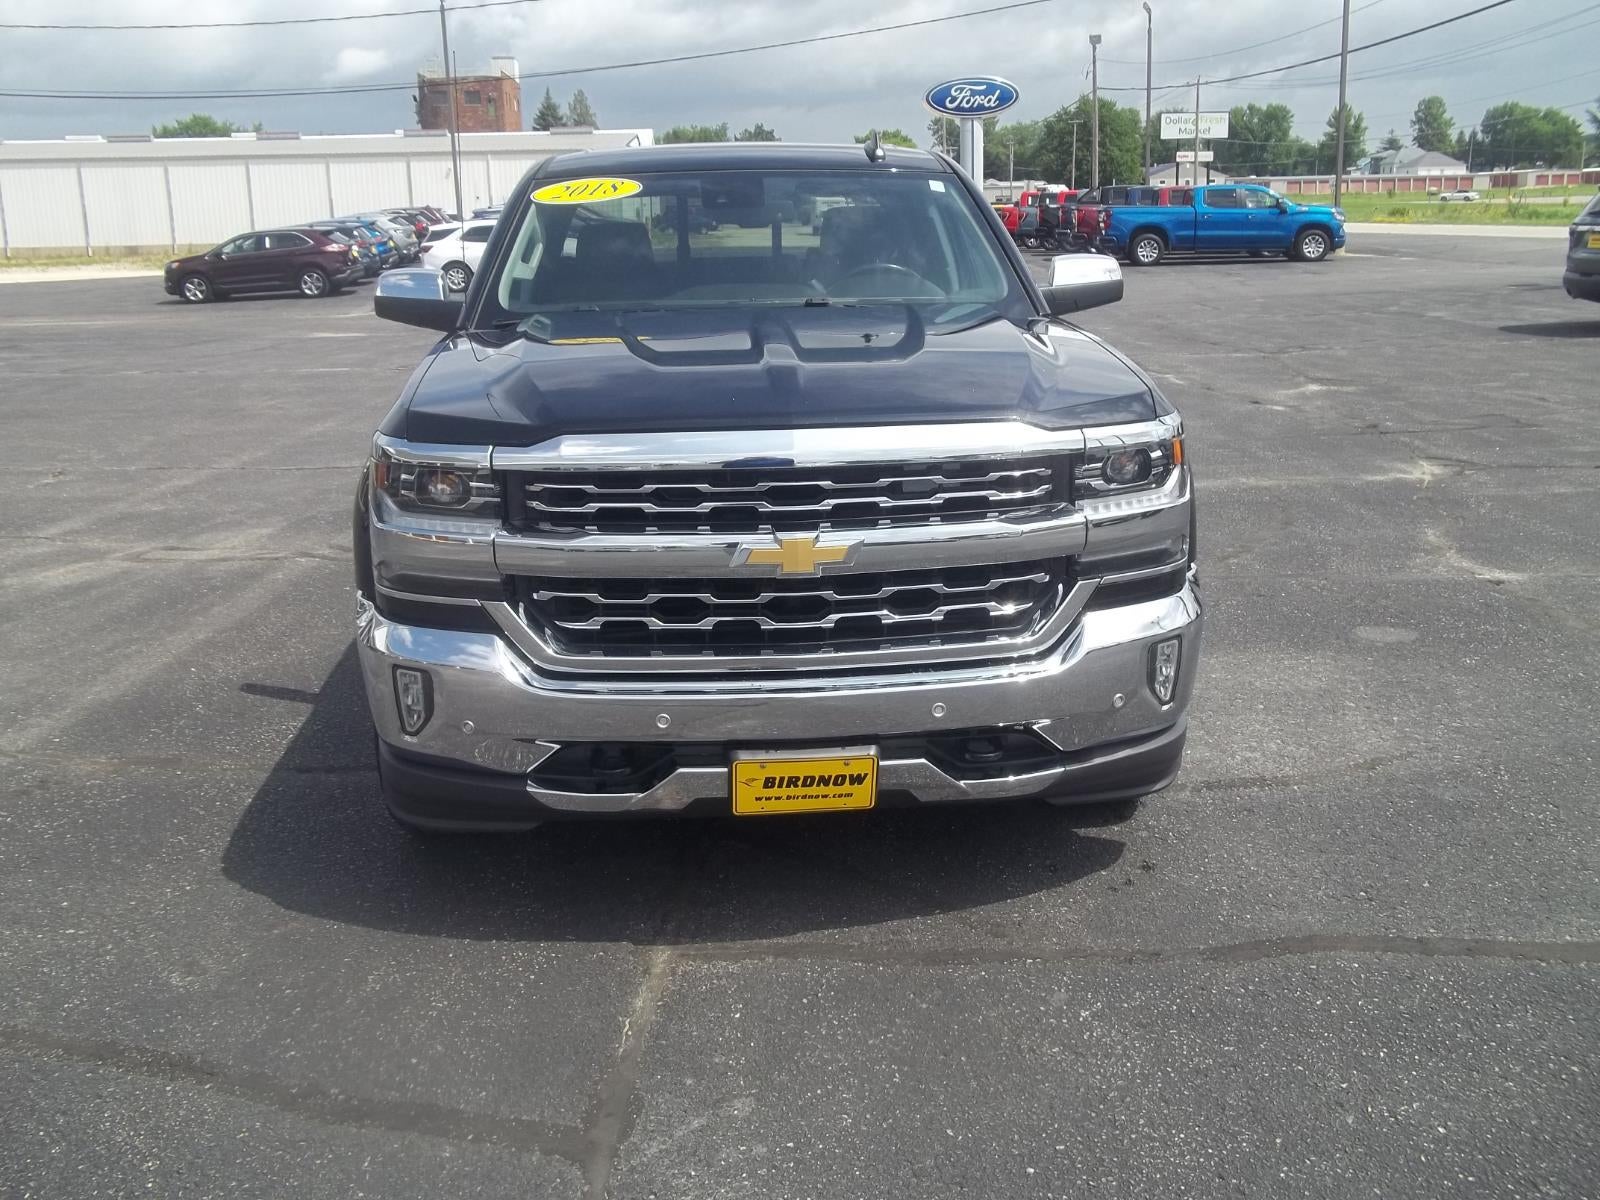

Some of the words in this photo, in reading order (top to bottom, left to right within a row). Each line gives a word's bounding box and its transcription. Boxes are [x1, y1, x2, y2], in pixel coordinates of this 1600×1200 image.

[945, 84, 1001, 109] Ford
[1164, 115, 1191, 125] Dollar
[551, 181, 625, 199] 2018
[762, 772, 869, 790] BIRDNOW
[755, 792, 854, 802] www.birdnow.com
